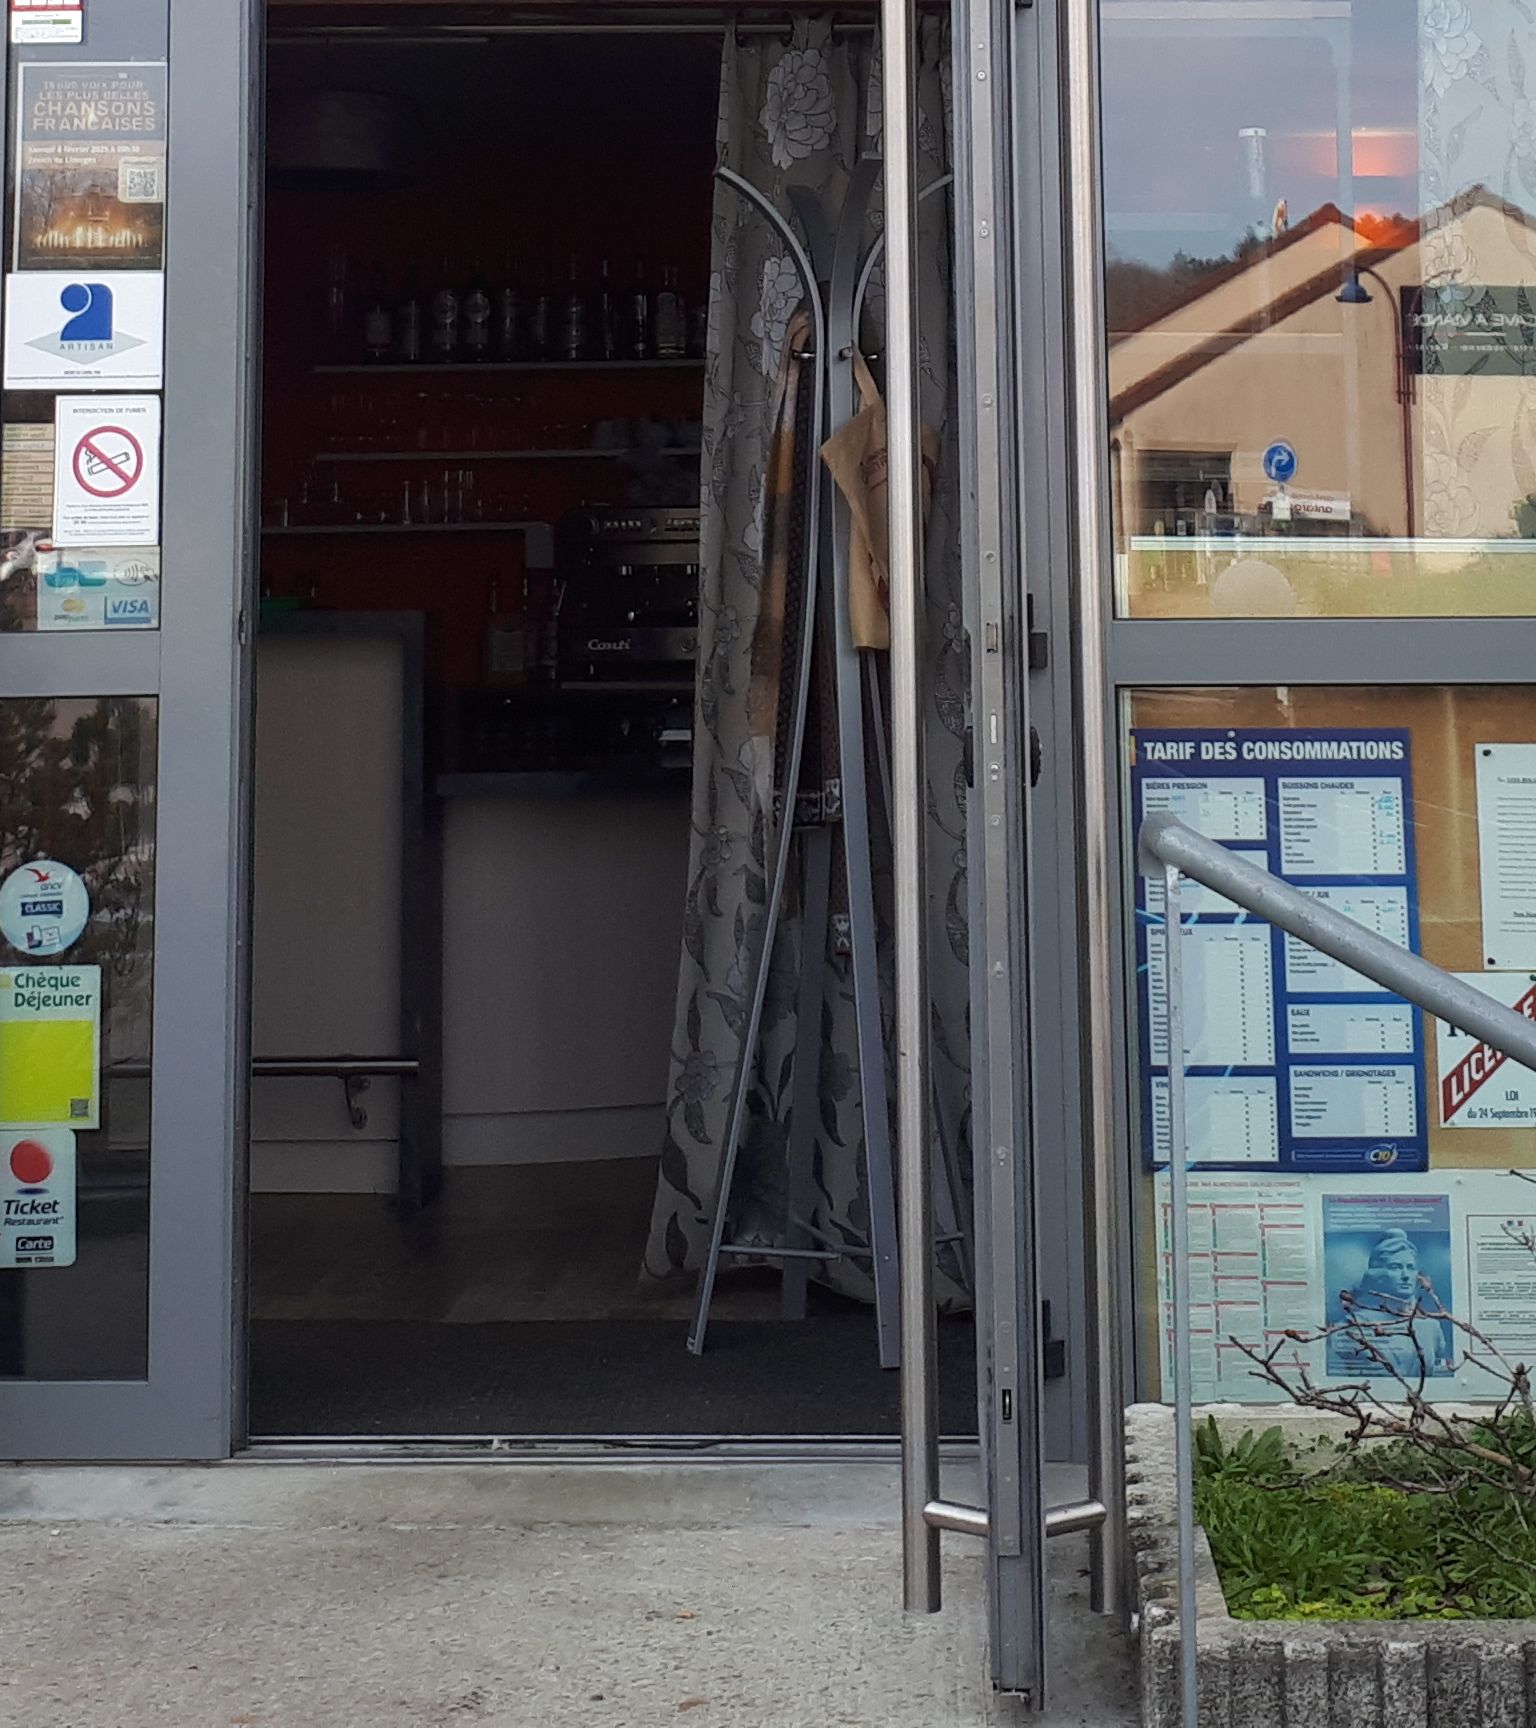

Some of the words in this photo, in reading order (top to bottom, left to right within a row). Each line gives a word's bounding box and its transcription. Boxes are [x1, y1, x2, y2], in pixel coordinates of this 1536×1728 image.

[112, 81, 144, 89] POUR
[39, 91, 63, 101] LES
[66, 91, 100, 101] PLUS
[103, 91, 150, 101] BELLES
[34, 101, 156, 116] CHANSONS
[59, 342, 114, 351] ARTISAN
[112, 599, 150, 614] VISA
[1144, 741, 1196, 760] TARIF
[1201, 741, 1237, 760] DES
[1242, 740, 1404, 760] CONSOMMATIONS
[1172, 782, 1208, 790] PRESSION
[1282, 781, 1319, 790] BOISSONS
[1320, 781, 1355, 790] CHAUDES
[24, 903, 61, 913] CLASSIC
[13, 972, 81, 991] Chèque
[13, 991, 93, 1011] Déjeuner
[1290, 1008, 1311, 1017] EAUX
[1505, 1090, 1519, 1101] LOI
[1467, 1108, 1478, 1119] du
[1478, 1107, 1488, 1118] 24
[1490, 1107, 1529, 1120] Septembre
[3, 1199, 61, 1216] Ticket
[17, 1238, 53, 1250] Carte
